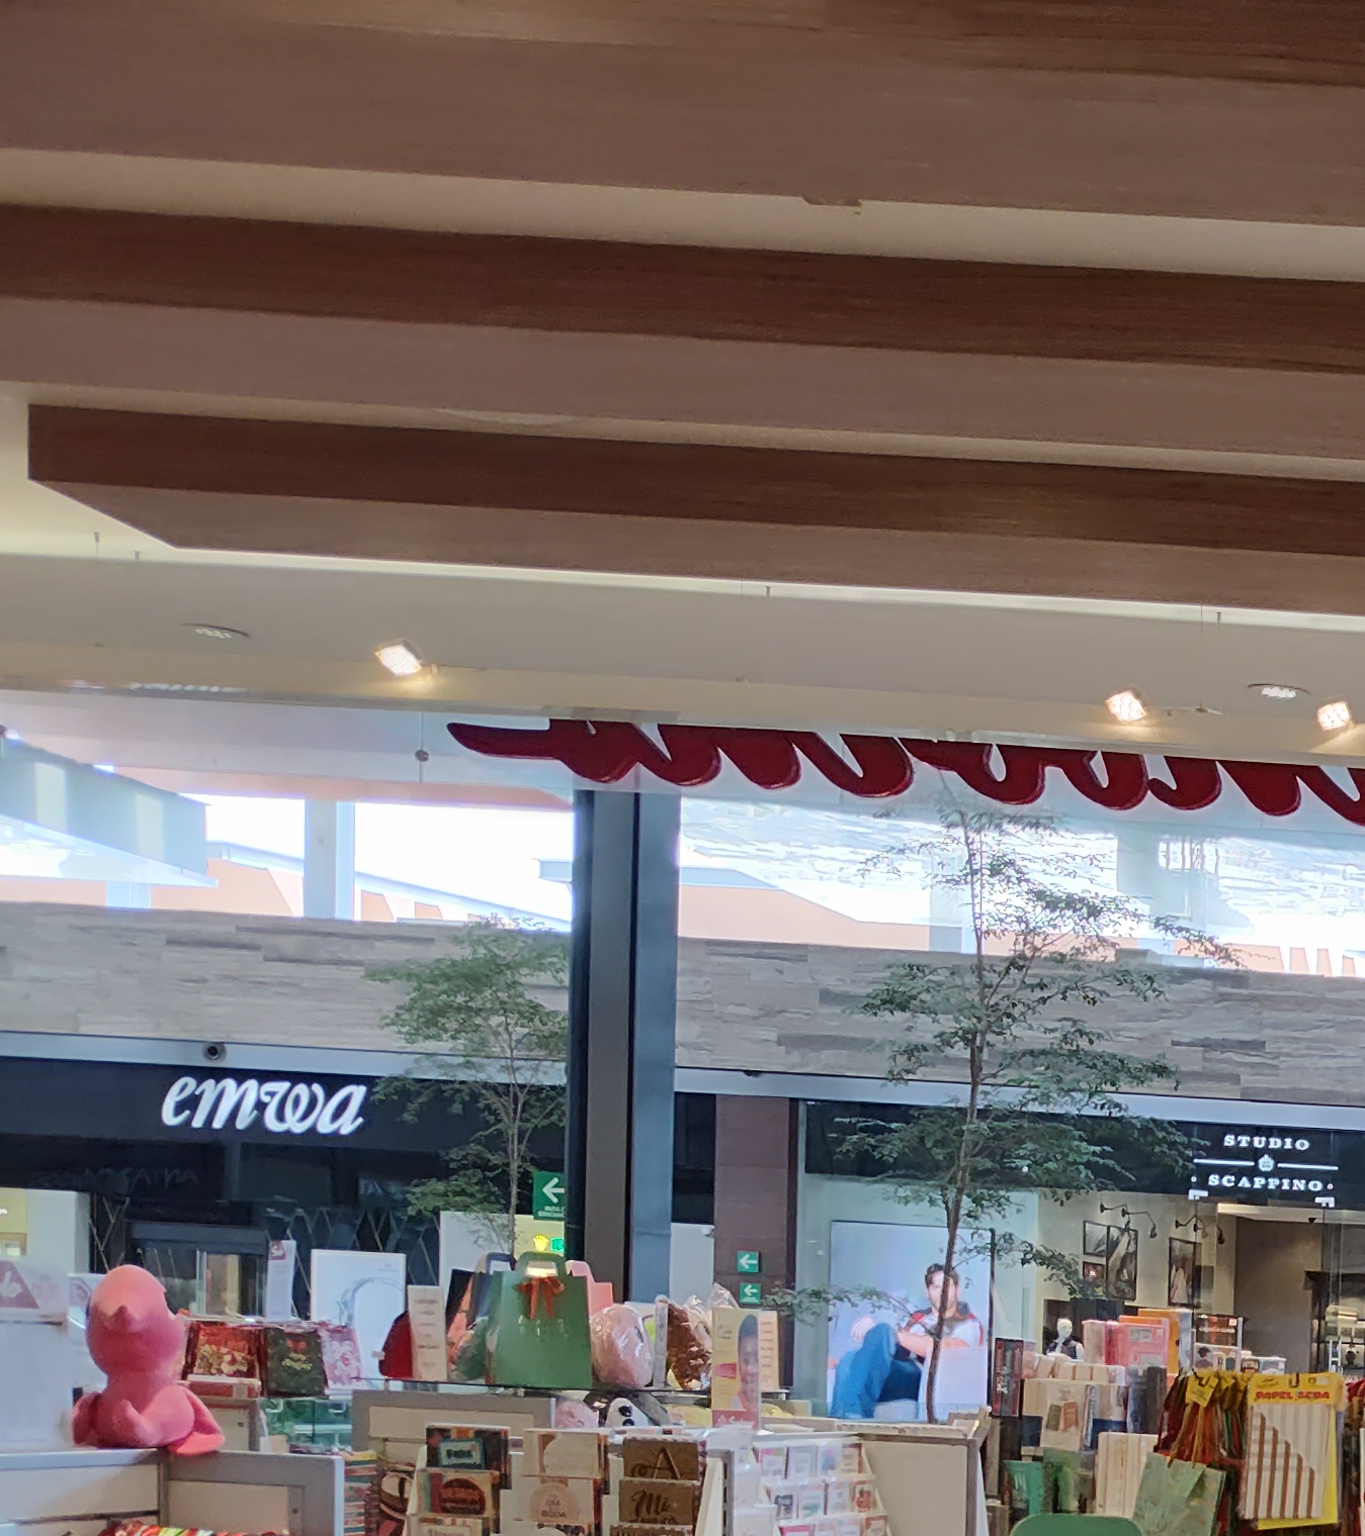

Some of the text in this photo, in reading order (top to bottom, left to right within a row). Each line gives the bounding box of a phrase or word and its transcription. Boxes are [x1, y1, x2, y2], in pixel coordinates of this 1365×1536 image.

[161, 1075, 369, 1137] emwa
[1223, 1134, 1310, 1151] STUDIO
[1207, 1174, 1323, 1192] SCAPPINO
